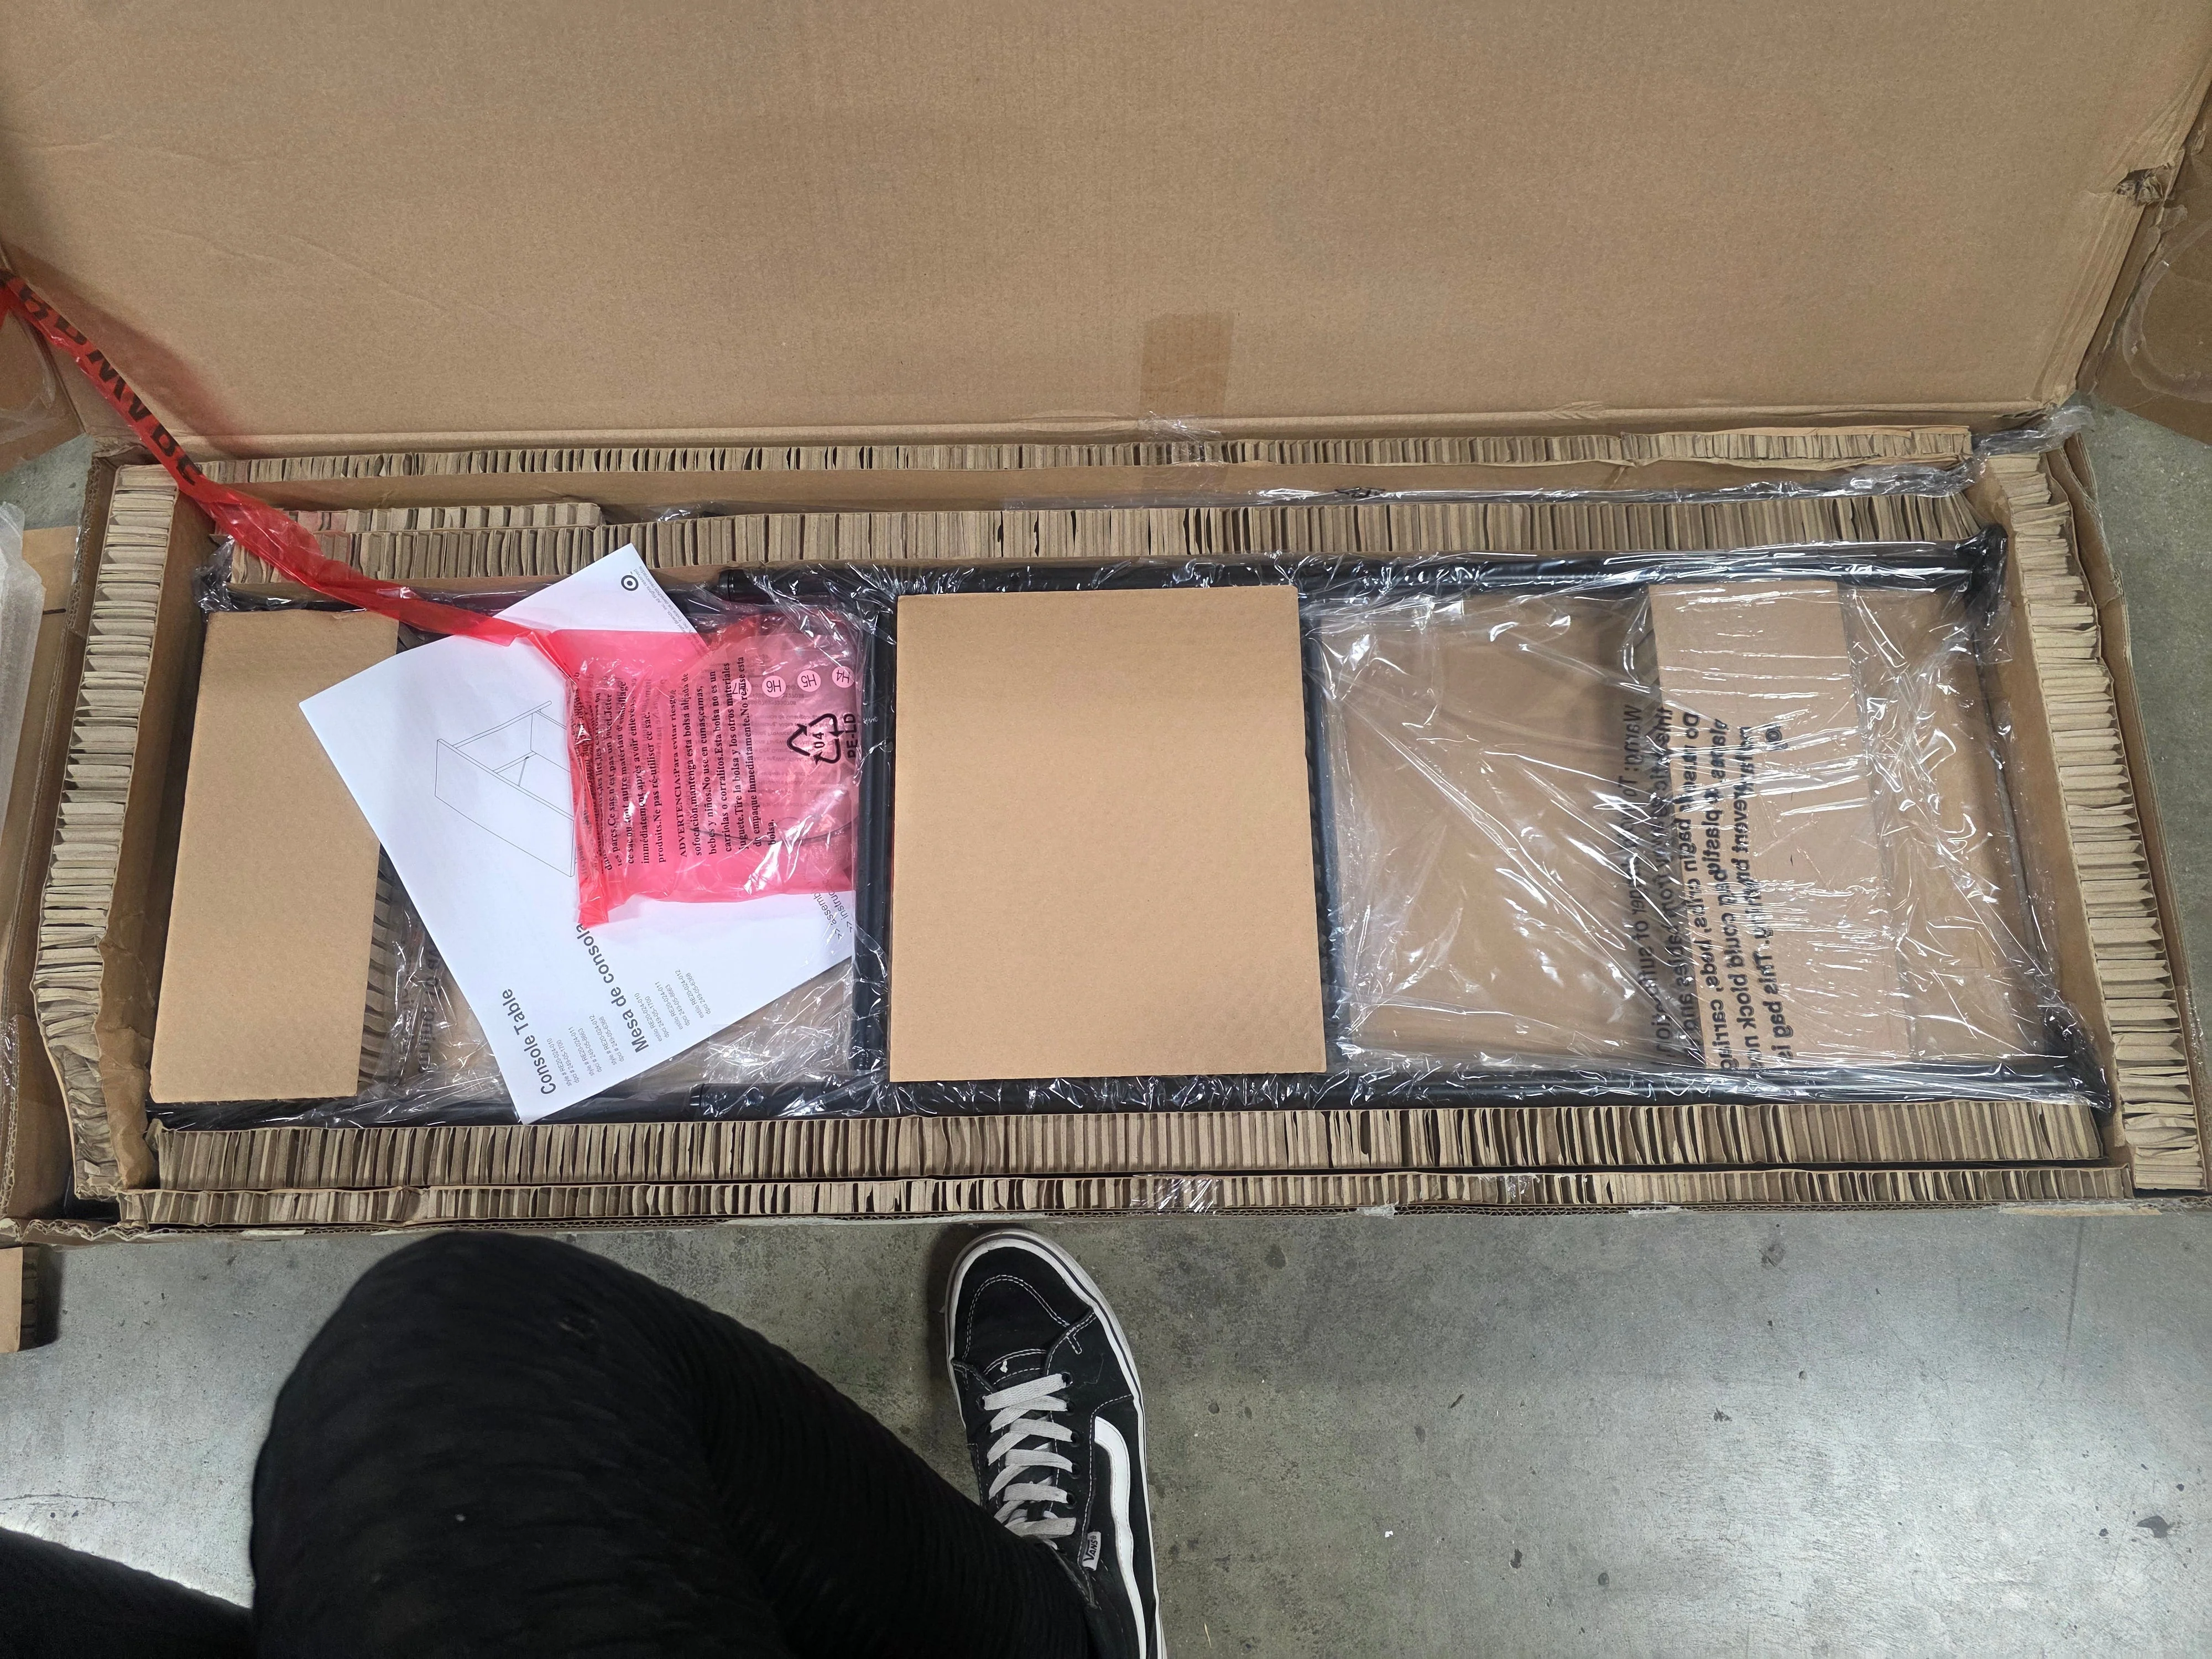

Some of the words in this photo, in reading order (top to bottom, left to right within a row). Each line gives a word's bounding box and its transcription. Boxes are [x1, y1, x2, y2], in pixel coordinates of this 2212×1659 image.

[708, 670, 718, 683] un
[735, 656, 745, 672] esta
[681, 672, 690, 682] de
[710, 684, 718, 693] es
[718, 662, 737, 706] materiales
[766, 680, 782, 693] H6
[801, 674, 817, 688] H5
[836, 670, 850, 684] H4
[594, 692, 601, 703] ou
[711, 695, 719, 707] no
[644, 711, 652, 728] sac.
[681, 712, 691, 737] bolsa
[711, 708, 721, 732] bolsa
[726, 708, 736, 732] otros
[603, 741, 613, 753] un
[646, 731, 653, 740] ce
[670, 723, 679, 749] evitar
[685, 739, 693, 757] esta
[728, 733, 737, 747] los
[739, 702, 757, 793] inmediatamente.No
[812, 732, 826, 749] 04
[617, 734, 627, 774] matériau
[631, 738, 640, 762] avoir
[701, 746, 708, 757] en
[607, 756, 615, 770] pas
[647, 743, 658, 788] ré-utiliser
[701, 759, 709, 774] use
[712, 733, 728, 801] corralitos.Esta
[730, 757, 740, 782] bolsa
[606, 773, 615, 794] n'est
[620, 776, 629, 801] autre
[635, 764, 644, 790] après
[733, 784, 741, 793] la
[606, 796, 615, 811] sac
[671, 752, 687, 858] ADVERTENCIA:Para
[701, 776, 713, 817] niños.No
[733, 794, 749, 850] juguete.Tire
[750, 794, 764, 834] empaque
[626, 826, 633, 837] ou
[653, 808, 665, 863] produits.Ne
[706, 828, 717, 854] bebes
[719, 812, 732, 852] carriolas
[766, 818, 776, 845] bolsa.
[627, 853, 634, 864] ce
[611, 987, 626, 1006] de
[655, 982, 676, 1016] RE20-024-011
[666, 984, 685, 1015] 249-05-8663
[675, 969, 697, 1005] RE20-024-012
[686, 973, 705, 1004] 249-05-6368
[503, 989, 528, 1035] Table
[635, 993, 655, 1029] RE20-024-010
[645, 997, 664, 1027] 249-05-1700
[681, 1015, 690, 1025] dpci
[578, 1028, 596, 1058] 249-05-8663
[589, 1015, 609, 1050] RE20-024-012
[599, 1016, 617, 1047] 249-05-6368
[623, 1009, 649, 1052] Mesa
[661, 1027, 669, 1037] dpci
[547, 1039, 565, 1072] RE20-024-010
[557, 1040, 573, 1070] 249-05-1700
[568, 1027, 588, 1061] RE20-024-011
[524, 1035, 556, 1094] Console
[1083, 1539, 1098, 1562] VANS
